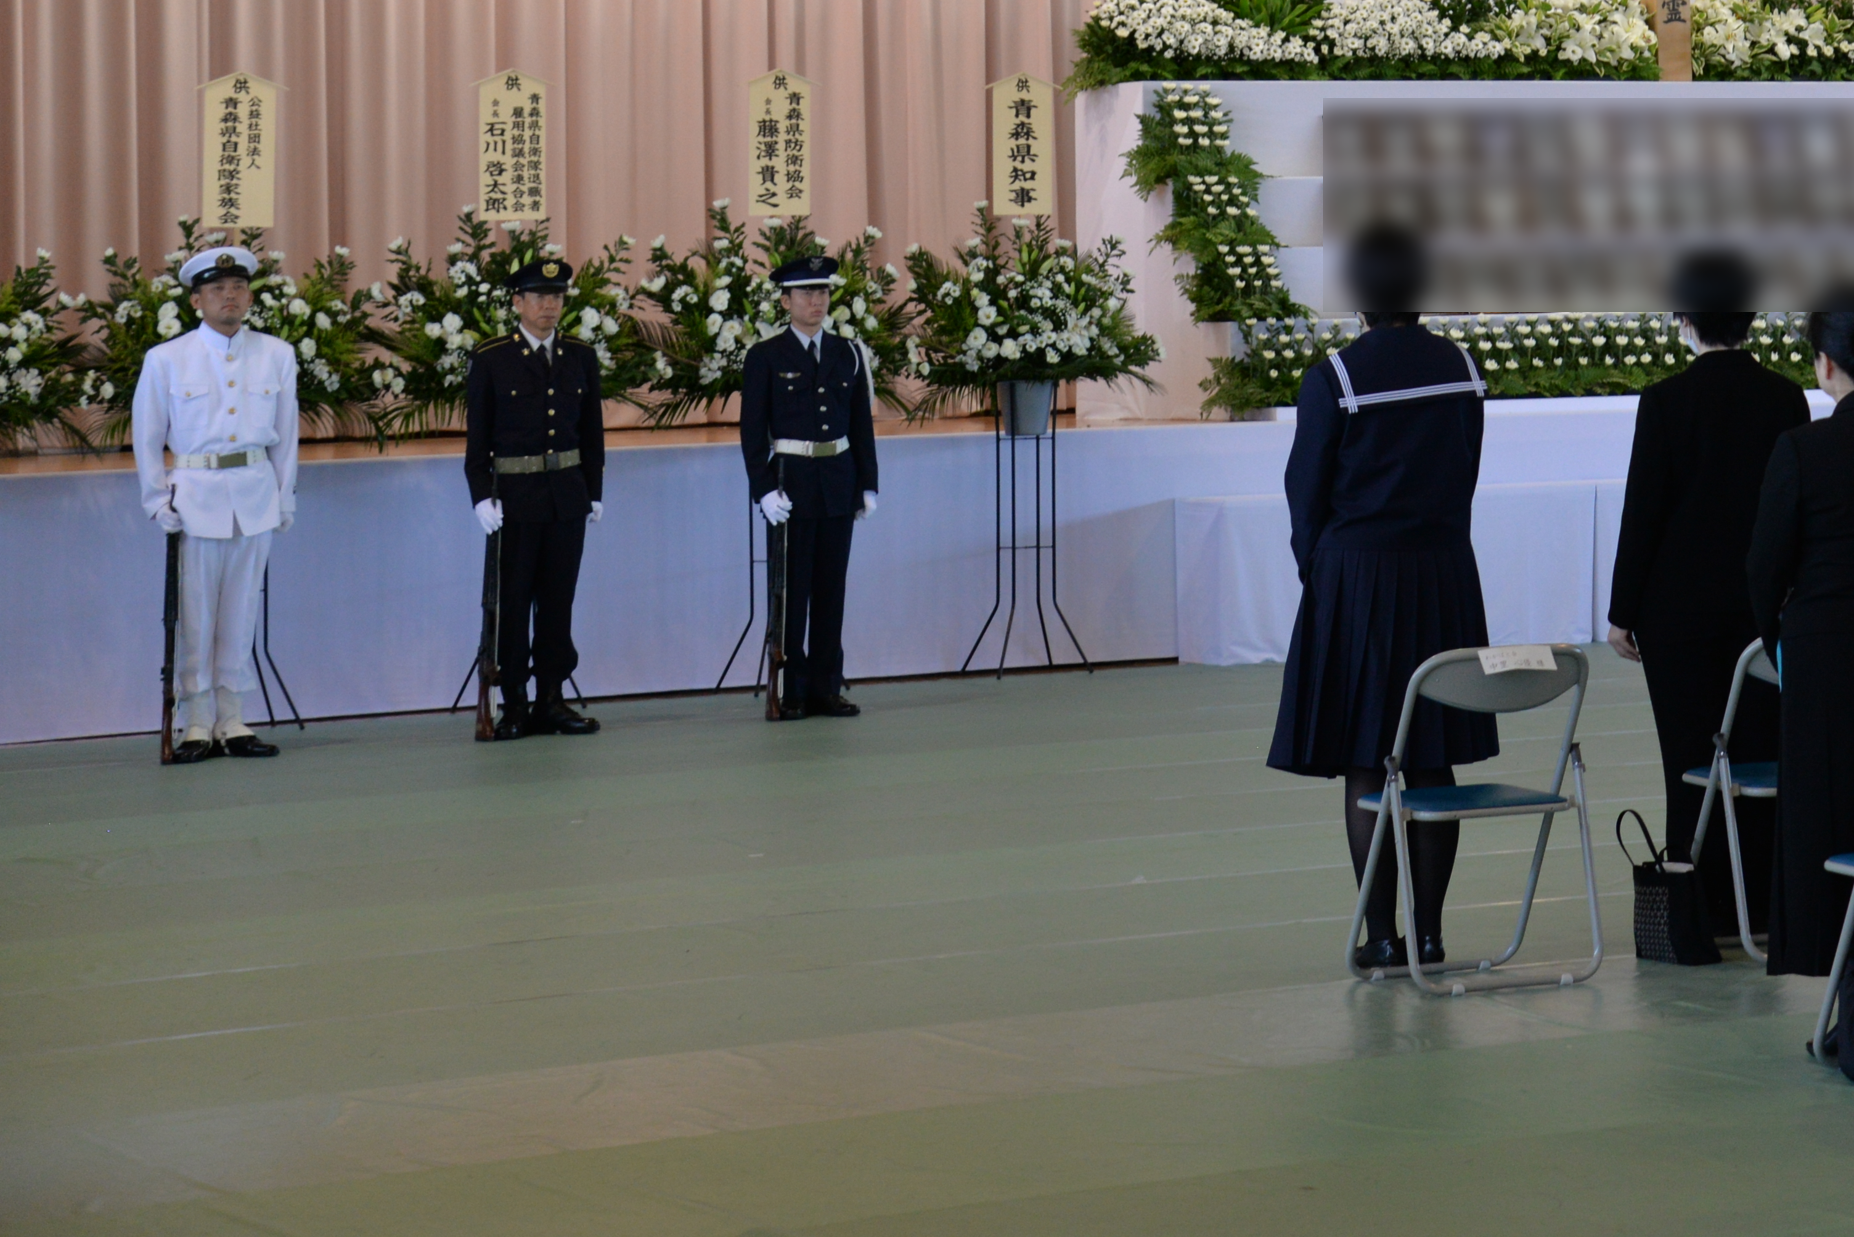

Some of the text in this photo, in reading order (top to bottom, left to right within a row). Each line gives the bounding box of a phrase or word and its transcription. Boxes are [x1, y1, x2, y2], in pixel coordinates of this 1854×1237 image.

[232, 78, 250, 95] 供
[504, 74, 522, 92] 供
[772, 74, 788, 91] 供
[1016, 77, 1031, 93] 供
[217, 96, 243, 225] 青森県自衛隊家族会
[246, 95, 262, 170] 公益社団法人
[510, 106, 526, 213] 雇用協議会連合会
[527, 93, 543, 212] 青森県自衛隊退職者
[784, 91, 805, 199] 青森県防衛協会
[1007, 98, 1039, 208] 青森県知事
